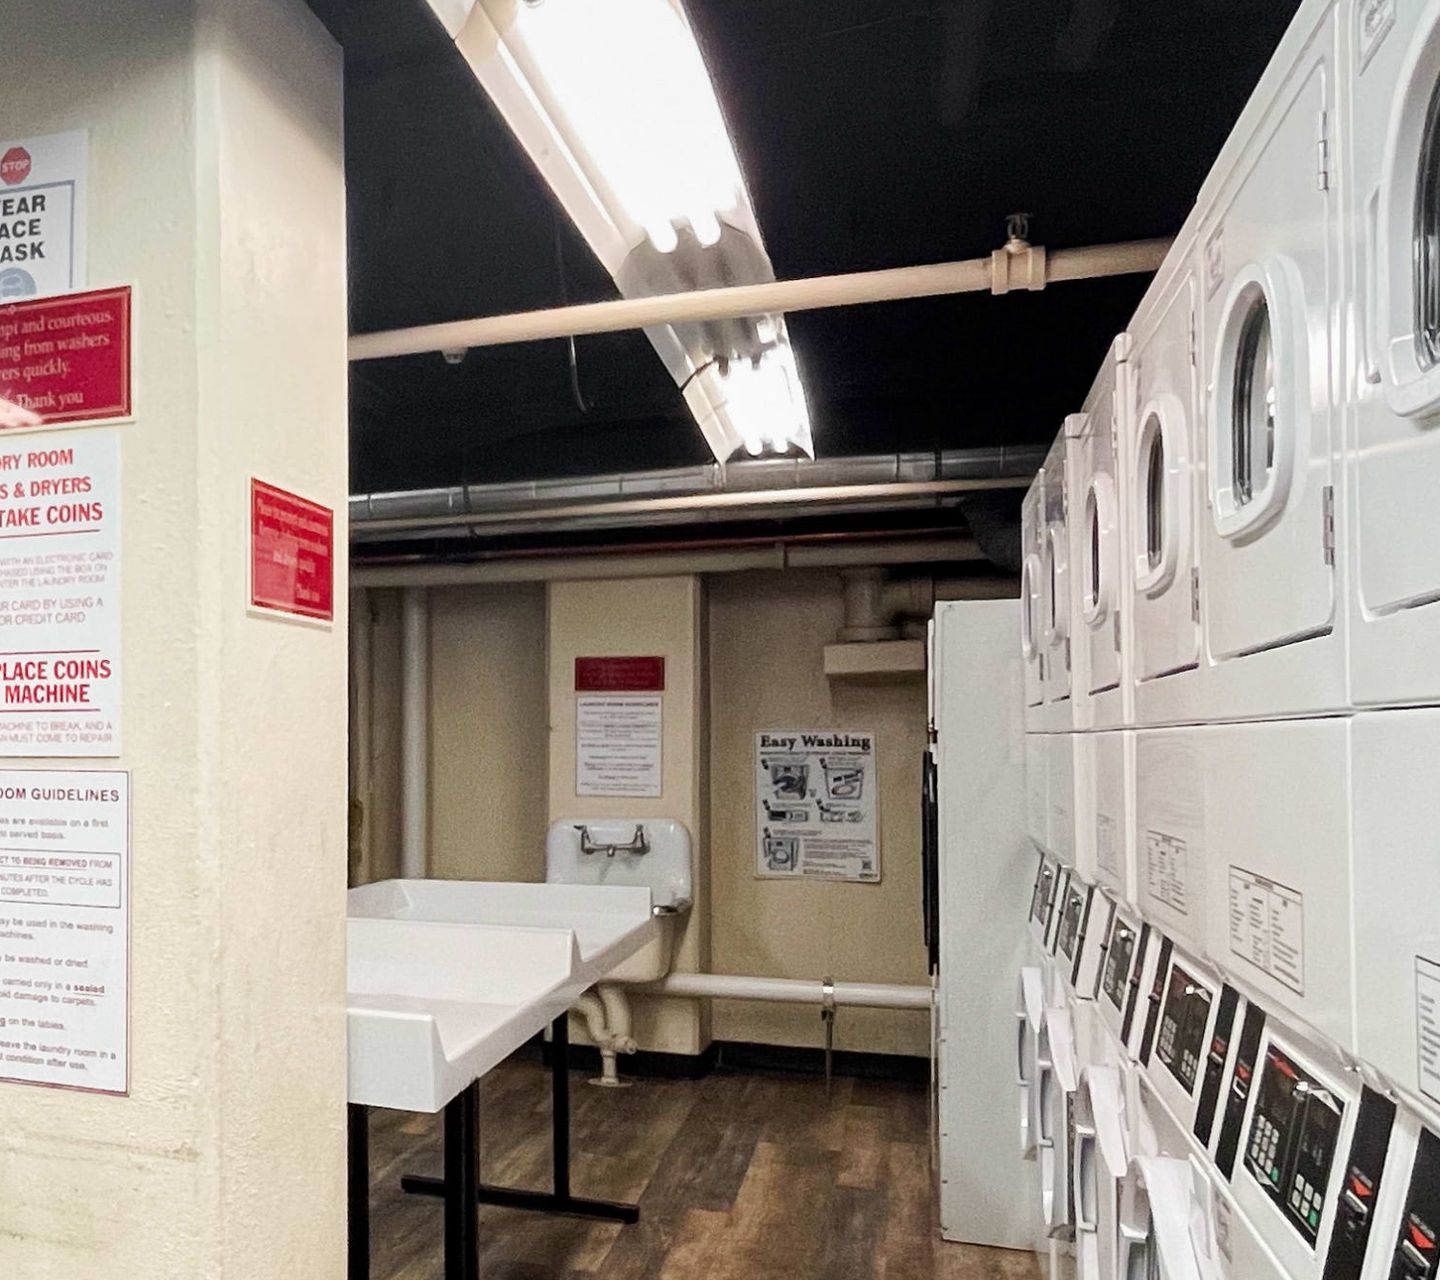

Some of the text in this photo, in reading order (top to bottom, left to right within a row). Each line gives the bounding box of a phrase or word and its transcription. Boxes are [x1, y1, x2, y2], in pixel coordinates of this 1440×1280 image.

[2, 159, 29, 173] STOP
[21, 318, 44, 333] and
[24, 339, 54, 355] from
[57, 333, 110, 351] washers
[23, 358, 70, 382] quickly.
[17, 392, 83, 410] Thank you
[28, 449, 73, 467] ROOM
[14, 482, 25, 498] &
[31, 476, 91, 496] DRYERS
[47, 502, 103, 523] COINS
[89, 552, 113, 561] CARD
[12, 599, 40, 610] CARD
[43, 598, 56, 609] BY
[60, 597, 93, 608] USING
[97, 597, 103, 607] A
[15, 613, 52, 624] CREDIT
[55, 612, 86, 623] CARD
[54, 660, 111, 679] COINS
[5, 684, 90, 703] MACHINE
[760, 734, 871, 751] Easy Washing
[31, 788, 119, 802] GUIDELINES
